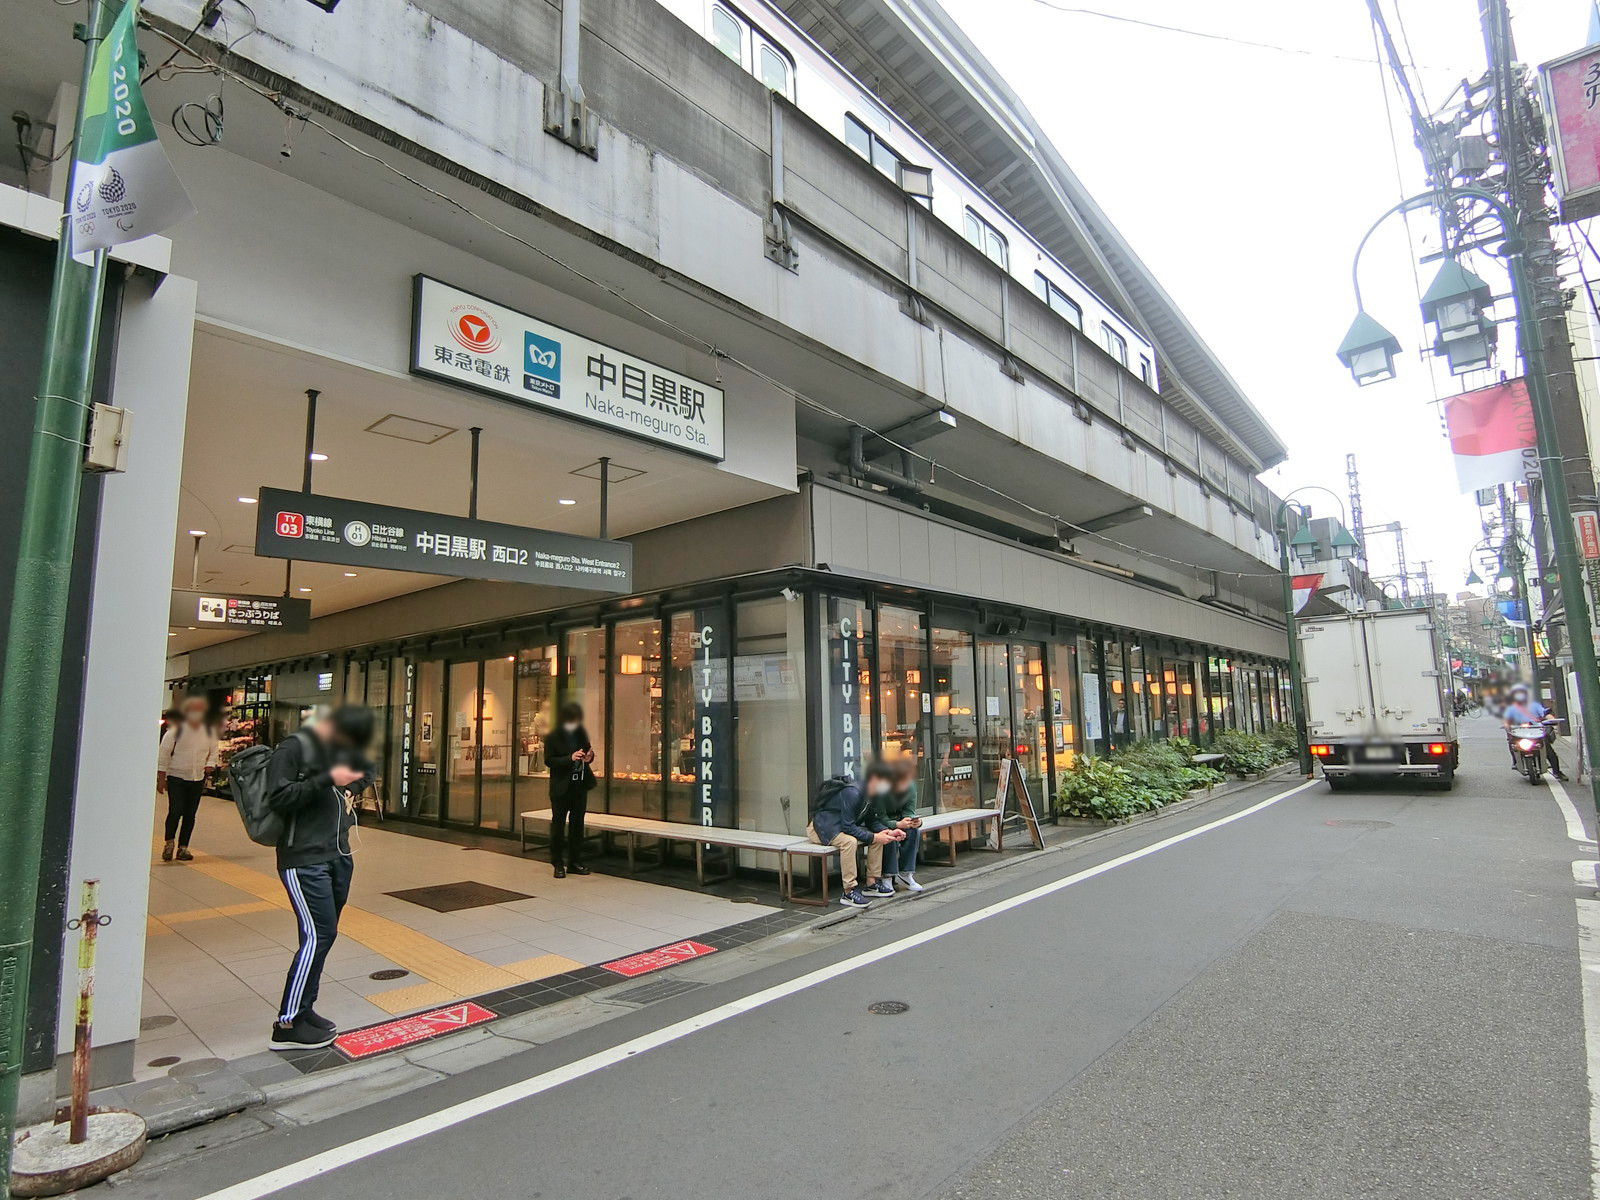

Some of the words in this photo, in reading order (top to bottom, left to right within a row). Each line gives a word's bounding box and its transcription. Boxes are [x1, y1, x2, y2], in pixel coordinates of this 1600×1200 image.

[113, 68, 136, 136] 2020
[102, 206, 120, 215] TOKYO
[121, 203, 137, 212] 2020
[467, 304, 499, 330] CORPORATION
[434, 345, 511, 384] 東急電鉄
[530, 378, 554, 390] 東京メトロ
[587, 353, 705, 425] 中目黒駅
[586, 392, 681, 436] Naka-meguro
[685, 425, 709, 446] Sta.
[281, 523, 298, 534] 03
[306, 515, 332, 528] 東横線
[306, 526, 323, 534] Toyoko
[372, 524, 404, 538] 日比谷線
[416, 531, 486, 560] 中目黒駅
[492, 545, 528, 565] 西口2
[535, 552, 570, 563] Naka-meguro
[581, 557, 594, 566] West
[228, 609, 280, 620] きっぷうりば
[701, 626, 713, 708] CITY
[840, 618, 852, 704] CITY
[402, 723, 410, 808] BAKERY
[702, 716, 713, 849] BAKER
